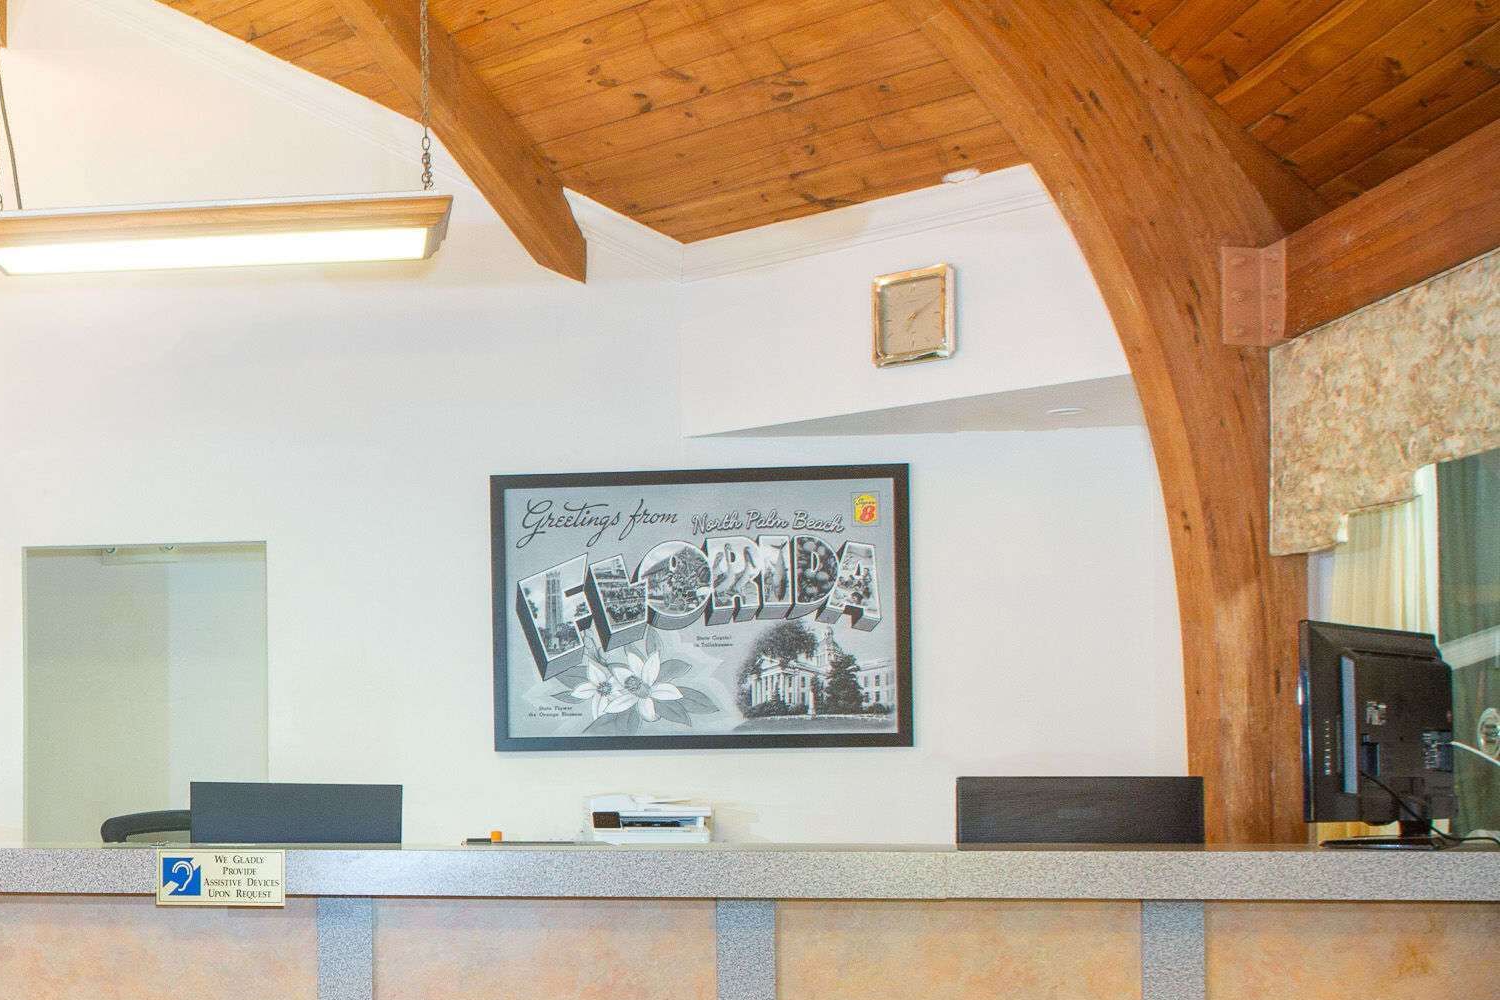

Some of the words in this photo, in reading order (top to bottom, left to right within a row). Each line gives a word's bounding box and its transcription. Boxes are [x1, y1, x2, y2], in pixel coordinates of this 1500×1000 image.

[516, 499, 621, 549] Greetings
[618, 498, 678, 541] from
[691, 510, 743, 535] North
[745, 508, 789, 530] Palm
[792, 509, 846, 533] Beach
[860, 505, 876, 522] 8
[516, 534, 884, 681] FLORIDA
